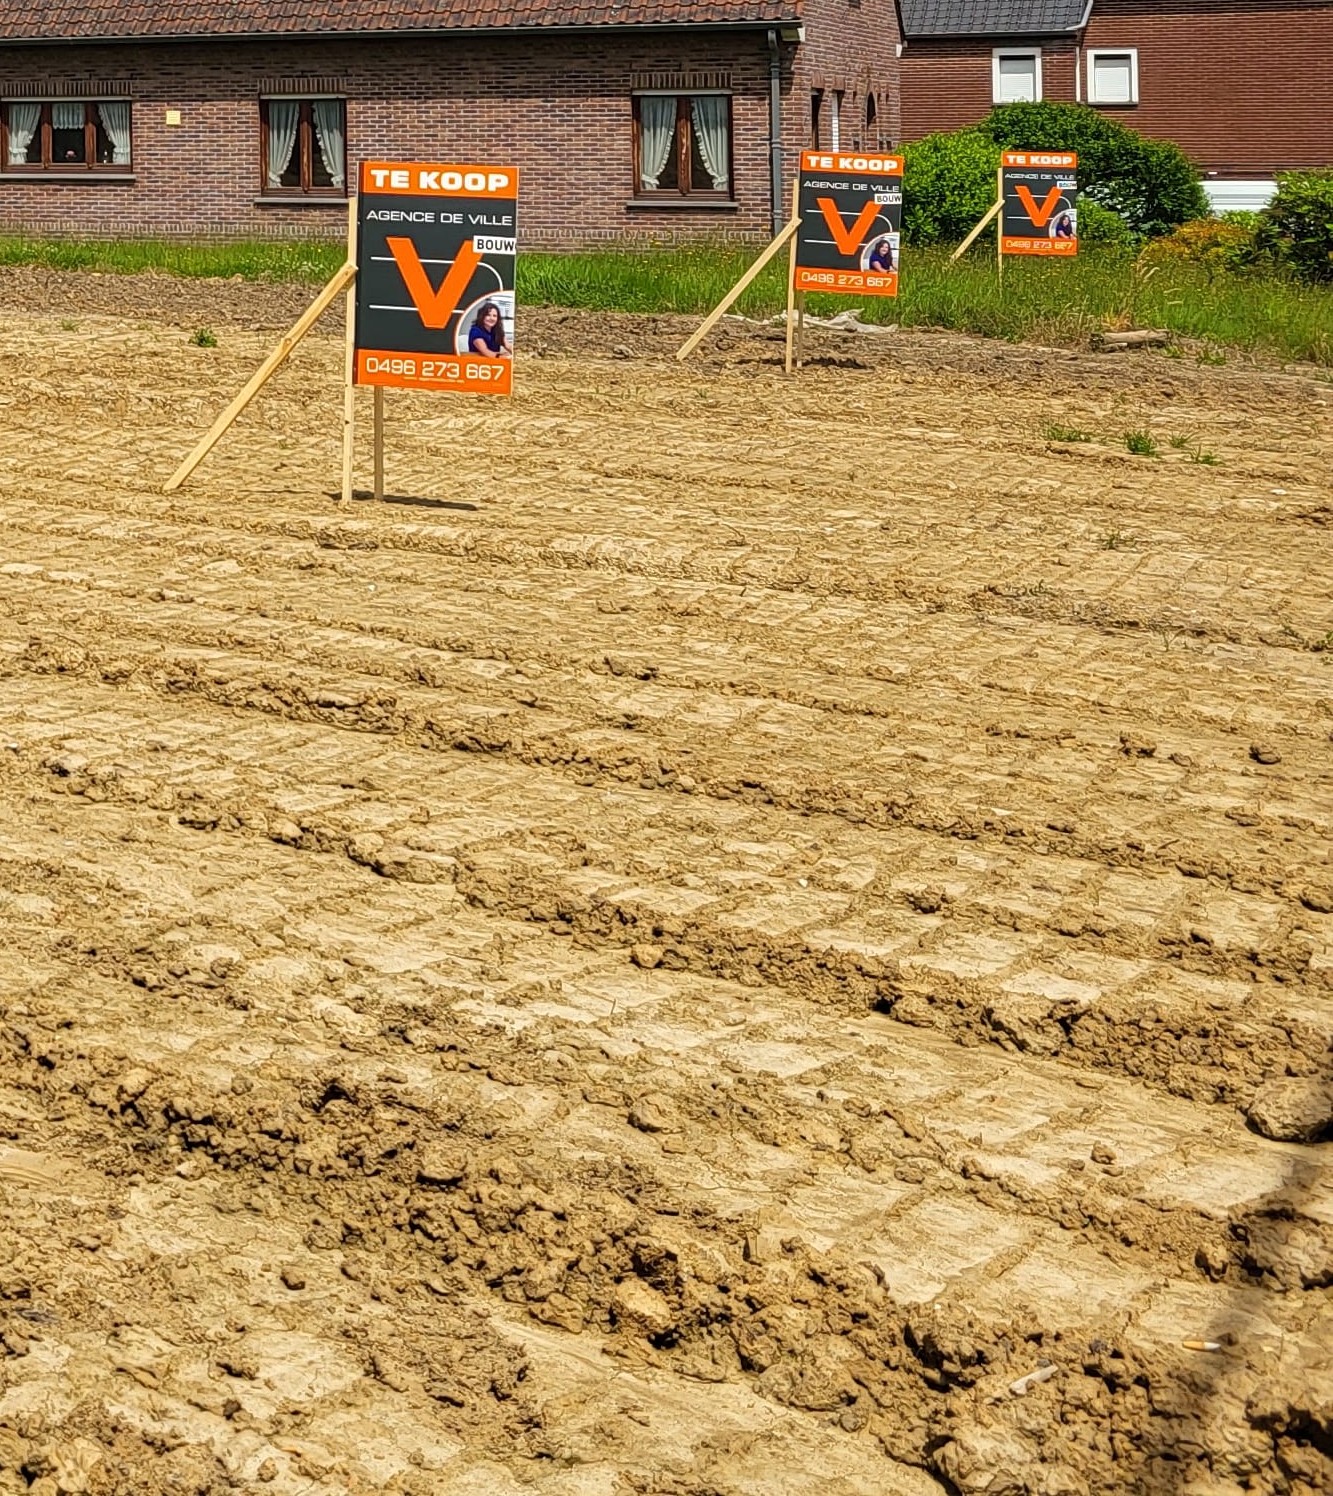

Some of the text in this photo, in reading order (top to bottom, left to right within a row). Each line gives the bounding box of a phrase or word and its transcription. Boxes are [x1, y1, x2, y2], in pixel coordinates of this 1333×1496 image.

[806, 155, 898, 172] TE KOOP
[1006, 155, 1073, 165] TE KOOP
[370, 169, 509, 192] TE KOOP
[803, 180, 900, 192] AGENCE DE VILLE
[366, 209, 513, 226] AGENCE DE VILLE
[476, 238, 517, 252] BOUW
[838, 274, 864, 286] 273
[866, 276, 892, 288] 667
[366, 357, 416, 375] 0496
[422, 361, 460, 378] 273
[466, 363, 505, 381] 667
